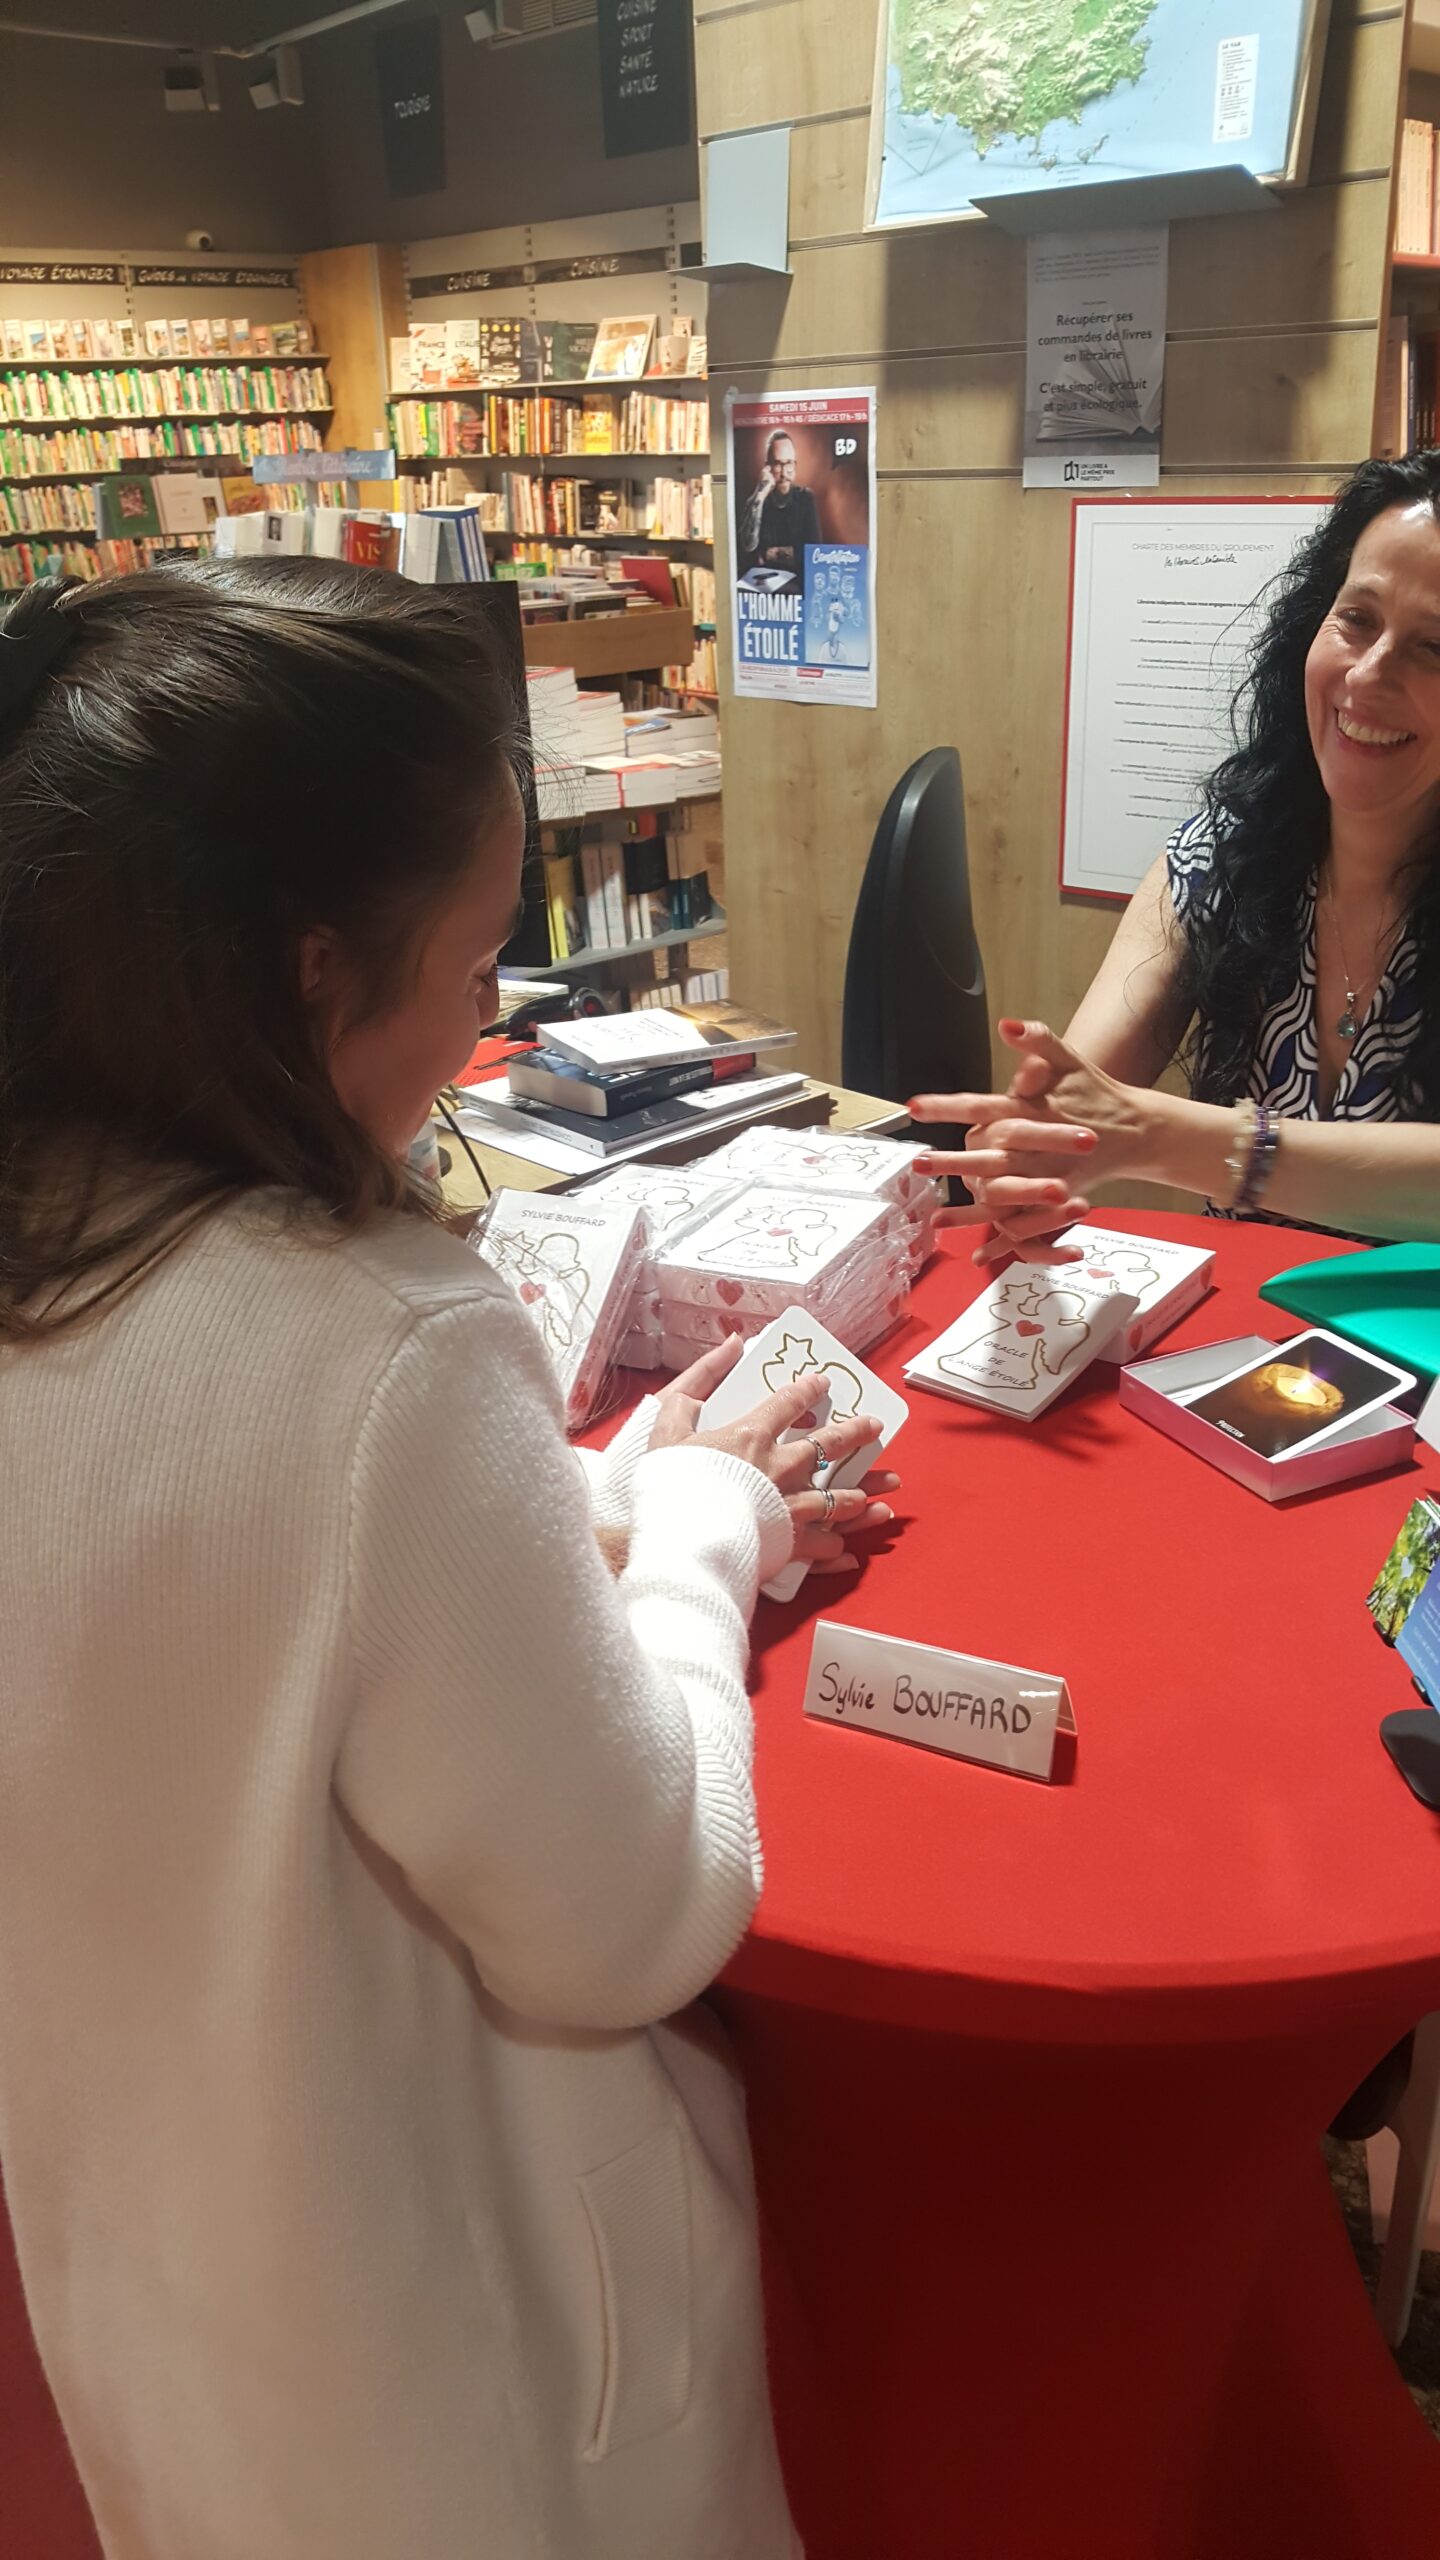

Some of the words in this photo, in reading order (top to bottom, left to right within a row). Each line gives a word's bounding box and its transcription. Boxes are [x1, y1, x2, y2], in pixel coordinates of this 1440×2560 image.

[621, 23, 654, 47] SPORT
[619, 74, 659, 98] NATURE
[571, 256, 620, 278] CUISINE
[446, 270, 491, 291] CUISINE
[1056, 312, 1112, 327] Récupérer
[1115, 312, 1133, 323] ses
[418, 339, 446, 349] FRANCE
[1038, 332, 1101, 346] commandes
[1104, 330, 1119, 342] de
[1122, 329, 1152, 341] livres
[1063, 352, 1076, 363] en
[1079, 349, 1122, 362] librairie
[1039, 381, 1066, 394] C'est
[1108, 378, 1147, 394] gratuit
[768, 402, 798, 412] SAMEDI
[808, 401, 828, 411] JUIN
[1043, 402, 1055, 413] et
[1057, 400, 1078, 415] plus
[835, 438, 857, 456] BD
[738, 592, 803, 623] L'HOMME
[744, 621, 800, 661] ÉTOILÉ
[521, 1209, 553, 1220] SYLVIE
[555, 1213, 606, 1227] BOUFFARD
[1094, 1235, 1125, 1244] SYLVIE
[1128, 1242, 1180, 1255] BOUFFARD
[1030, 1272, 1060, 1286] SYLVIE
[1061, 1282, 1110, 1299] BOUFFARD
[983, 1340, 1029, 1359] ORACLE
[988, 1356, 1007, 1366] DE
[988, 1369, 1030, 1387] ÉTOILÉ
[818, 1661, 875, 1714] Sylvie
[892, 1673, 1032, 1735] BOUFFARD
